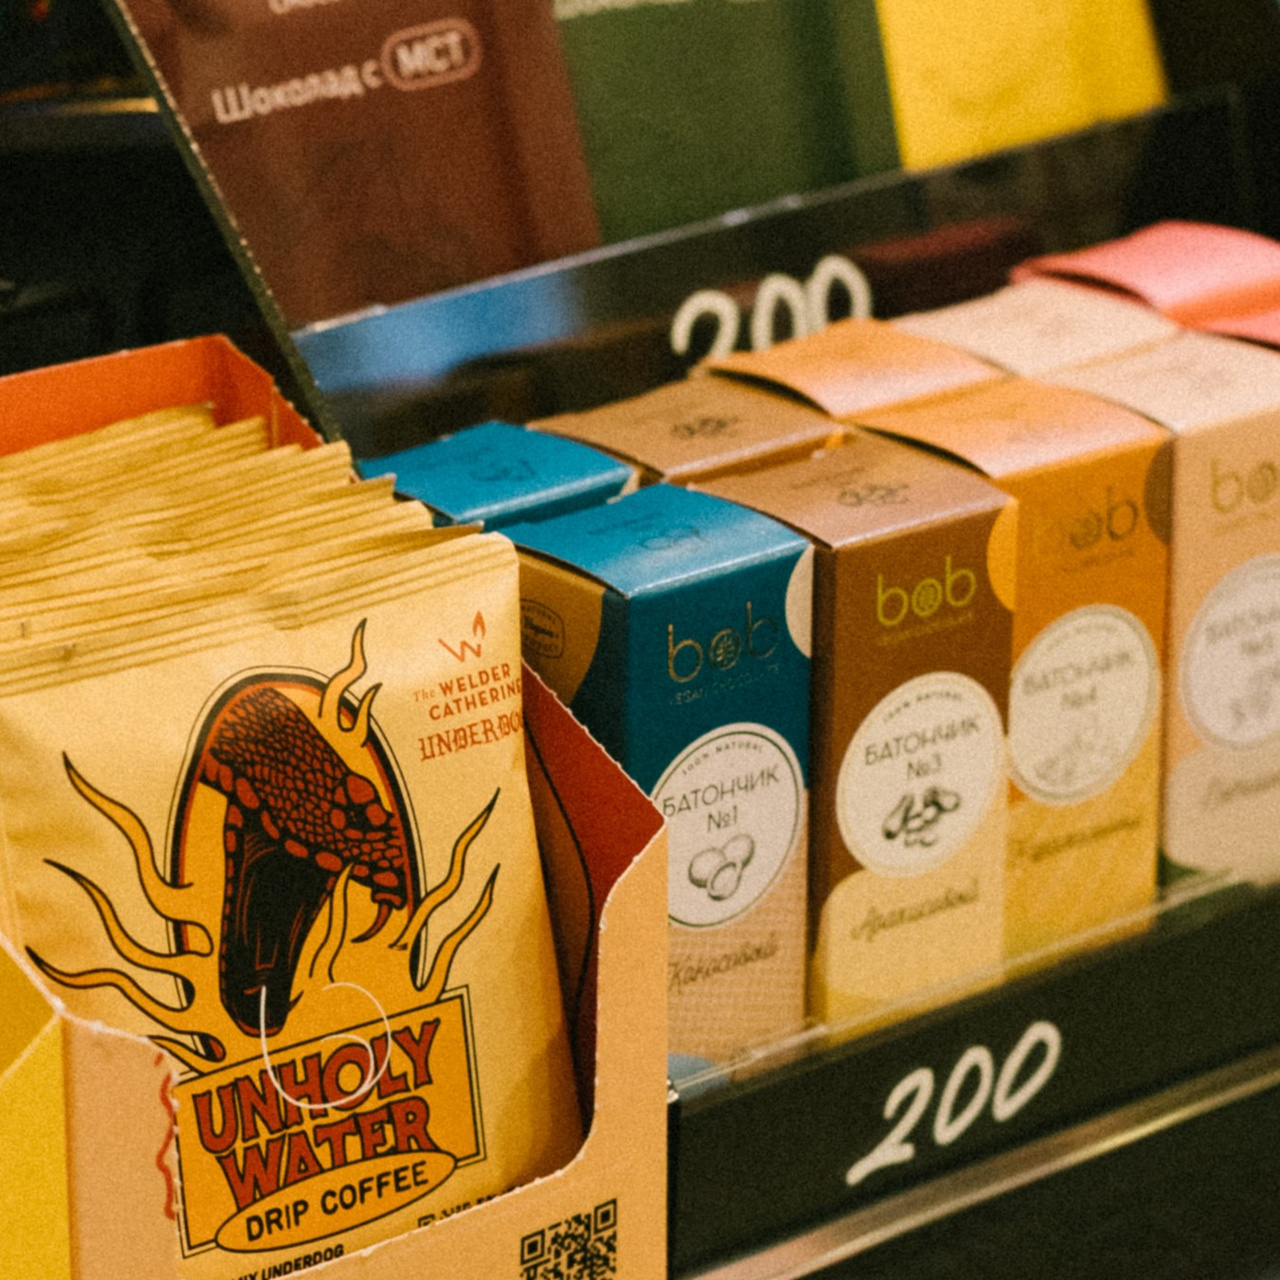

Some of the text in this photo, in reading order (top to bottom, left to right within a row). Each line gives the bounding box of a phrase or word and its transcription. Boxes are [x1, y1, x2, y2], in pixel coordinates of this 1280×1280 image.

[211, 64, 366, 124] Шоколад
[876, 555, 977, 627] bob
[668, 601, 779, 683] bob
[412, 663, 511, 702] The WELDER
[429, 677, 522, 721] CATHERINE
[418, 709, 525, 762] UNDERDO
[864, 713, 982, 767] БАТОНЧИК
[663, 763, 781, 818] БАТОНЧИК
[707, 804, 739, 833] №1
[191, 1017, 441, 1155] UNHOLY
[846, 1020, 1063, 1187] 200
[216, 1096, 441, 1212] WATER
[320, 1160, 430, 1216] COFFEE
[246, 1199, 310, 1243] DRIP
[261, 1244, 345, 1280] UNDERDOG
